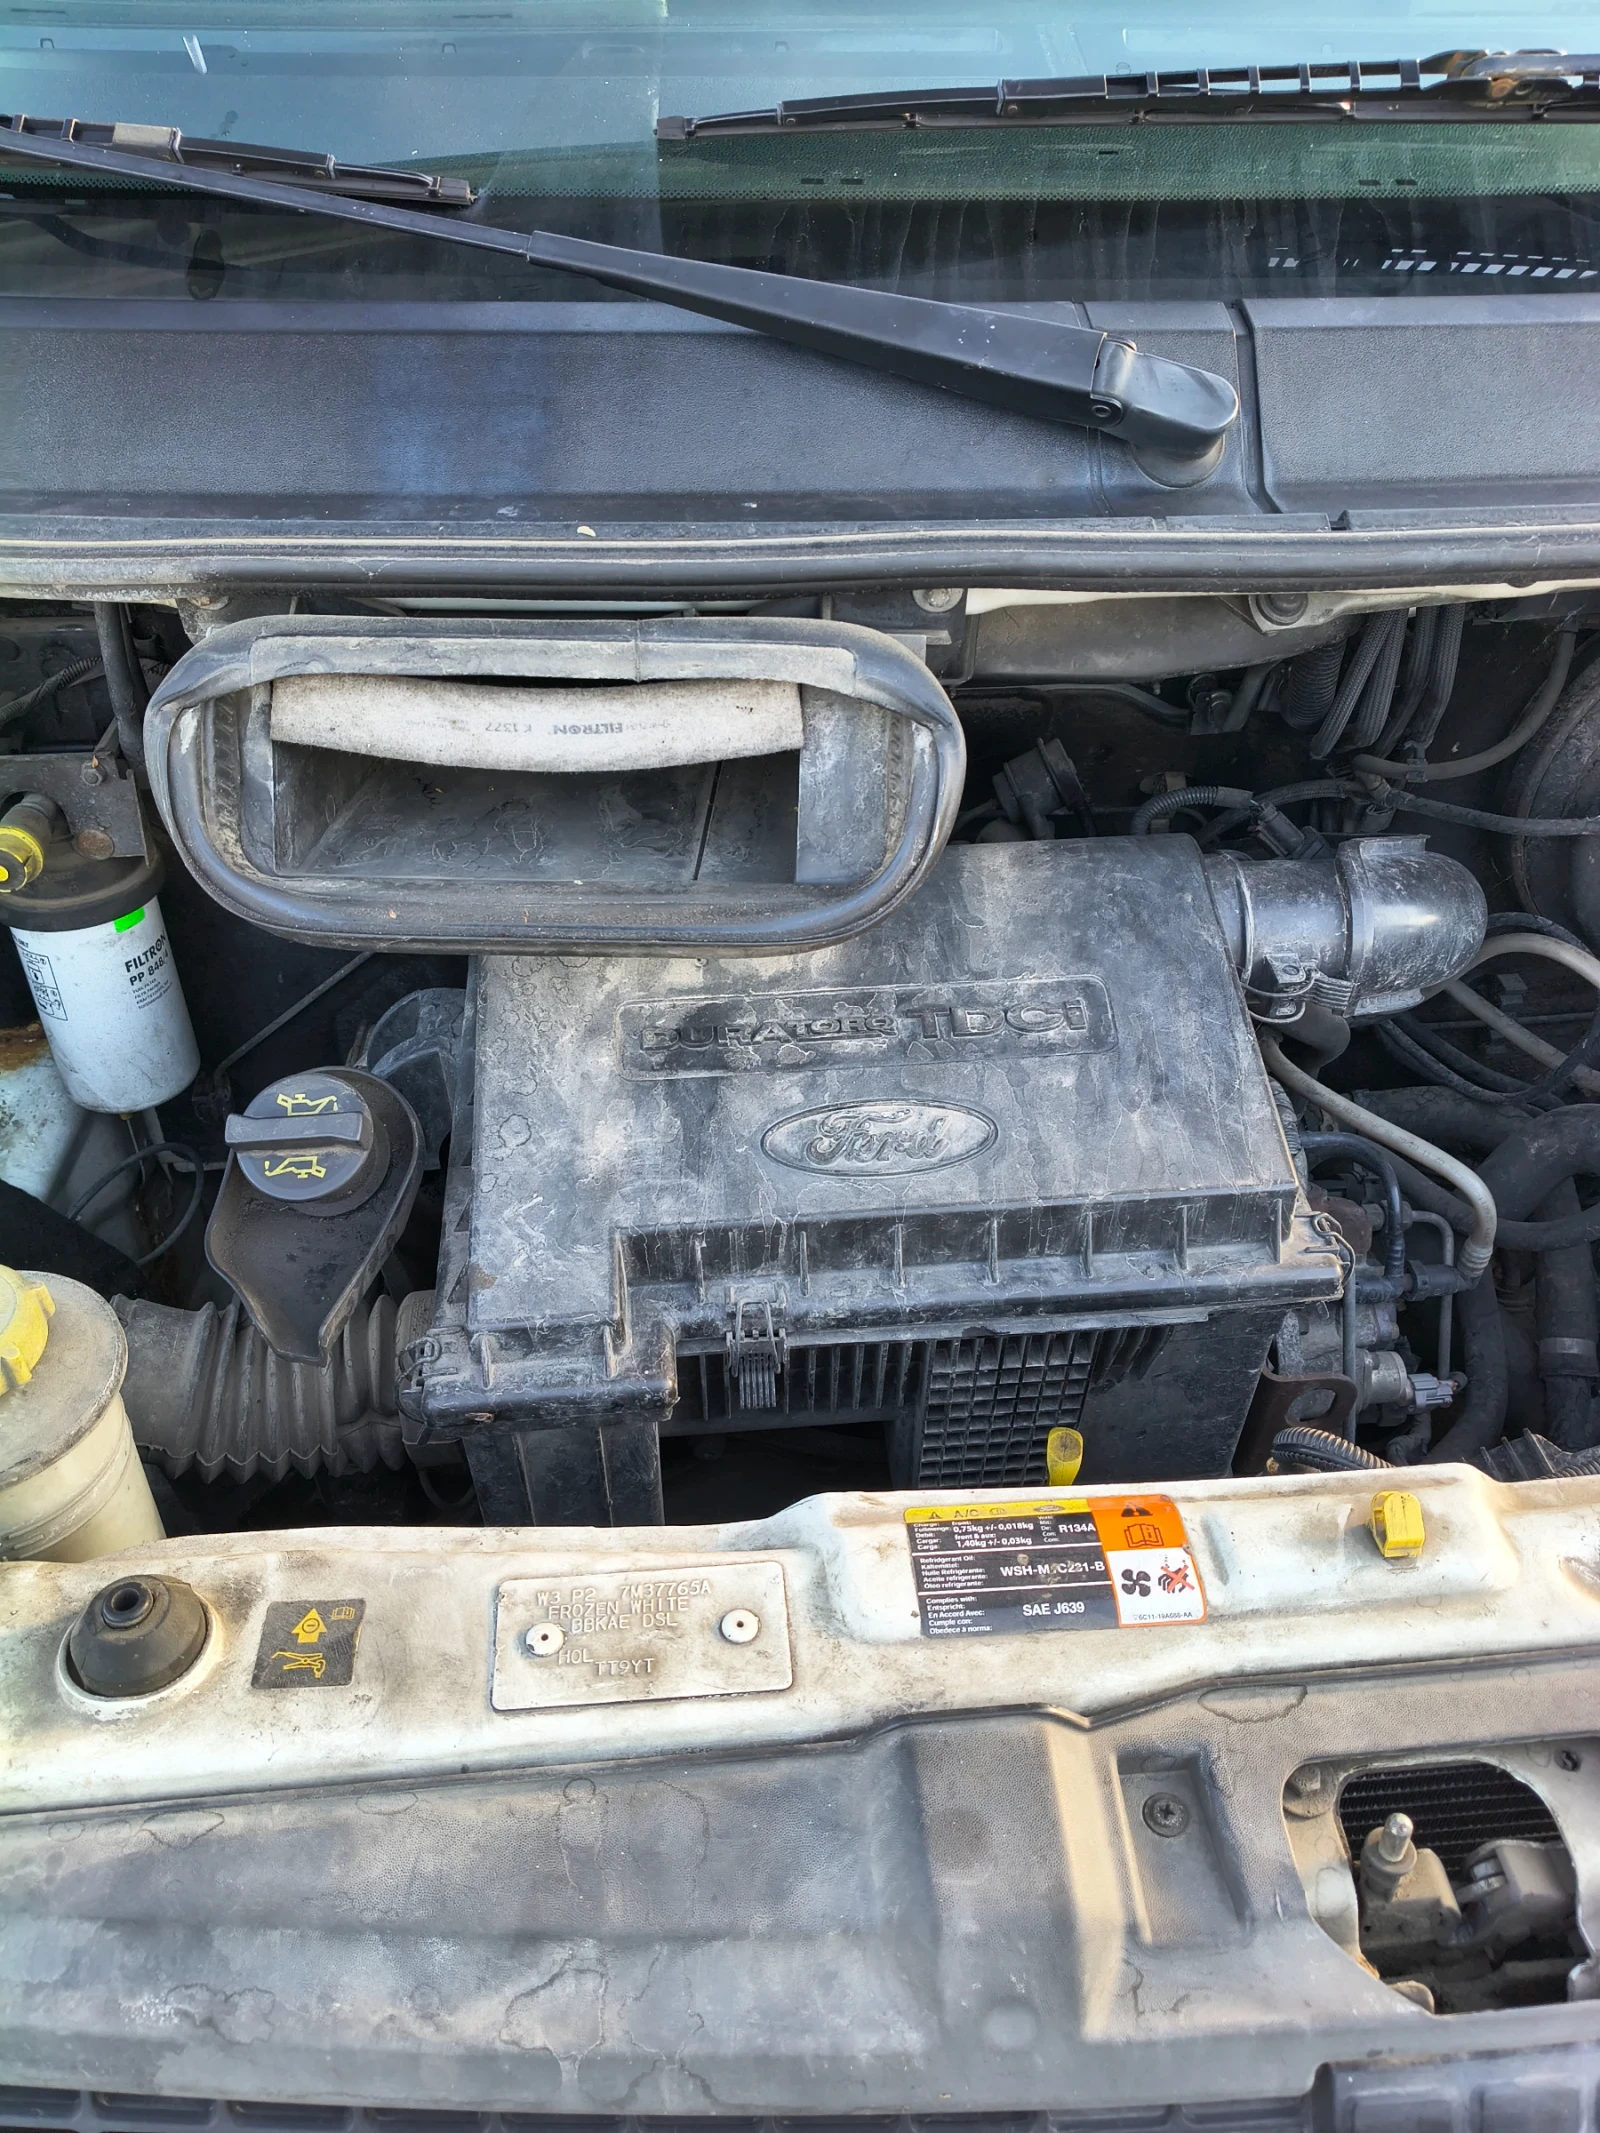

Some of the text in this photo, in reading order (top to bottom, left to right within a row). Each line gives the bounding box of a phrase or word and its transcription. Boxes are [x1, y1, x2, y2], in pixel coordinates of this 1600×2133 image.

[485, 721, 519, 734] 1377
[553, 722, 624, 736] FILTRON
[124, 930, 166, 973] FILTRON
[129, 971, 145, 986] PP
[804, 1106, 952, 1166] Ford
[954, 1509, 979, 1518] A/C
[953, 1525, 984, 1533] 0,75kg
[998, 1522, 1034, 1531] 0,018kg
[1058, 1522, 1097, 1534] R134A
[956, 1536, 1033, 1548] 1,40kg +/- 0,03kg
[536, 1580, 712, 1606] W3 P2 7M37765A
[925, 1597, 959, 1605] Complies
[548, 1597, 690, 1620] FROZEN WHITE
[939, 1610, 965, 1618] Accord
[965, 1609, 985, 1617] Avec:
[1022, 1601, 1085, 1617] SAE J639
[571, 1614, 631, 1634] BBKAE
[641, 1612, 678, 1628] DSL
[928, 1619, 956, 1627] Cumple
[929, 1627, 961, 1635] Obedece
[967, 1625, 992, 1633] norma:
[558, 1649, 594, 1665] HOL
[594, 1658, 655, 1676] TT9YT
